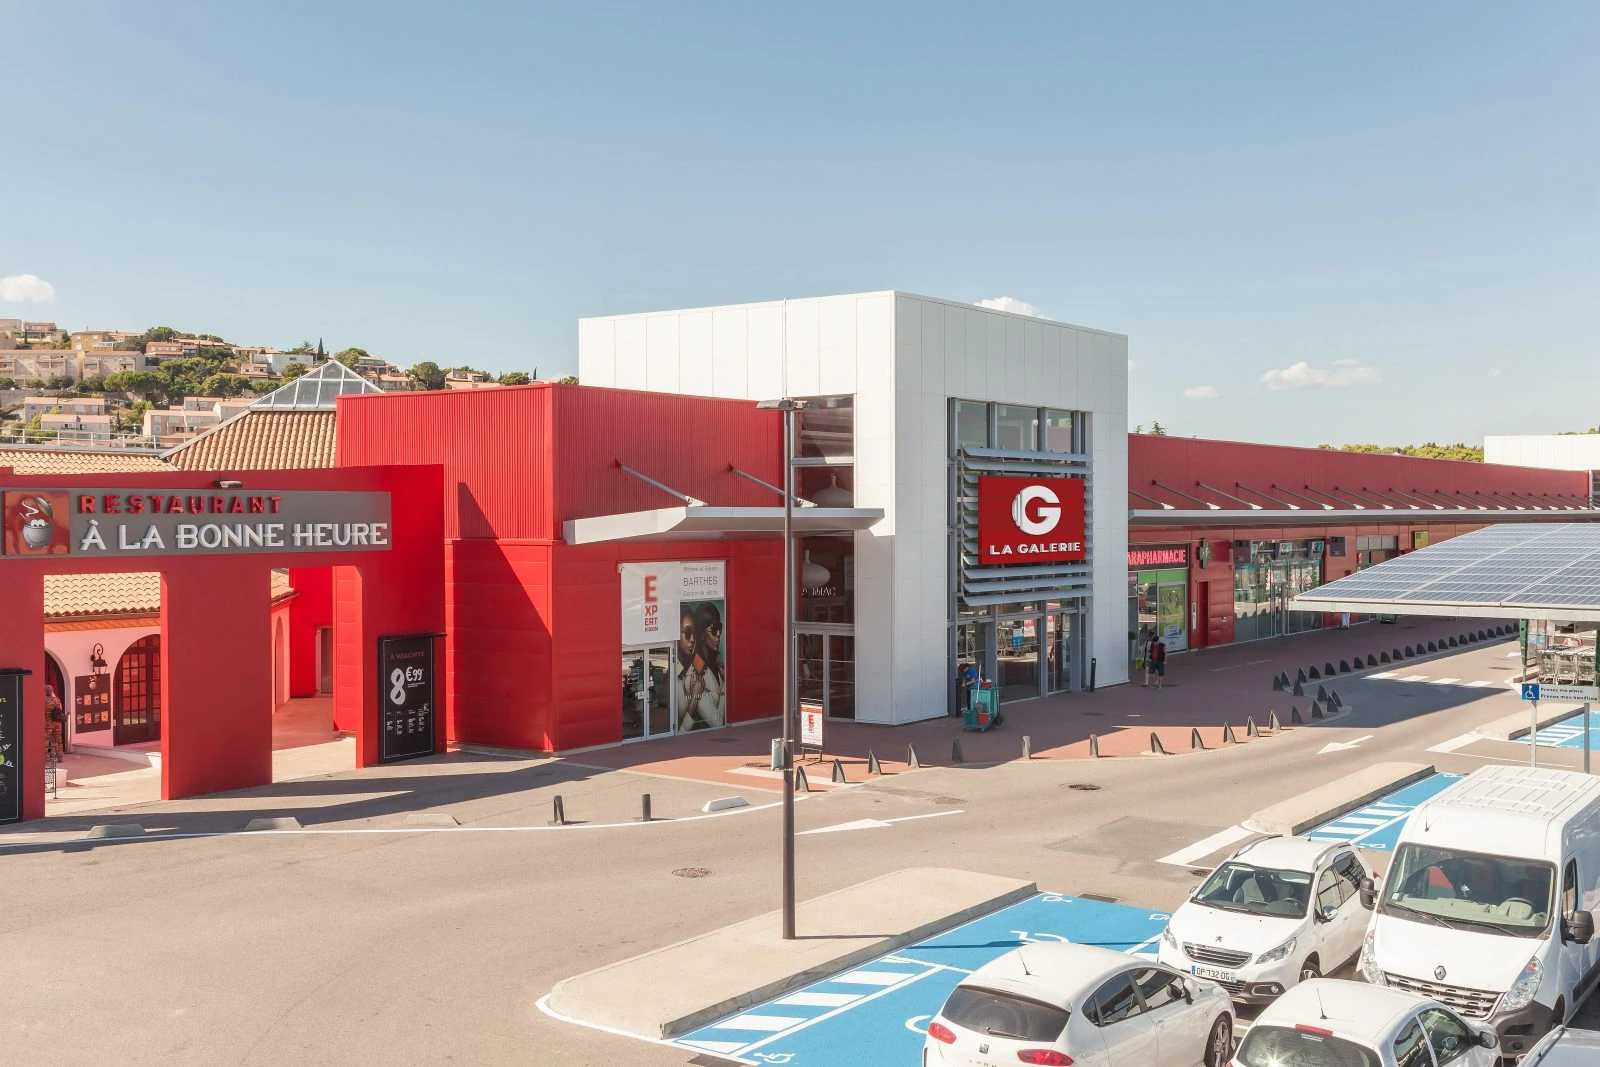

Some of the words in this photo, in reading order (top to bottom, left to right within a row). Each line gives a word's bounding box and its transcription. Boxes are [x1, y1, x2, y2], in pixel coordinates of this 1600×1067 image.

[78, 495, 283, 513] RESTAURANT
[1011, 485, 1062, 535] G
[80, 519, 106, 550] À
[118, 524, 165, 549] LA
[176, 523, 285, 548] BONNE
[292, 522, 388, 546] HEURE
[989, 544, 1012, 555] LA
[1017, 542, 1081, 554] GALERIE
[645, 575, 657, 602] E
[684, 576, 717, 587] BARTHES
[645, 605, 658, 616] XP
[645, 617, 658, 626] ERT
